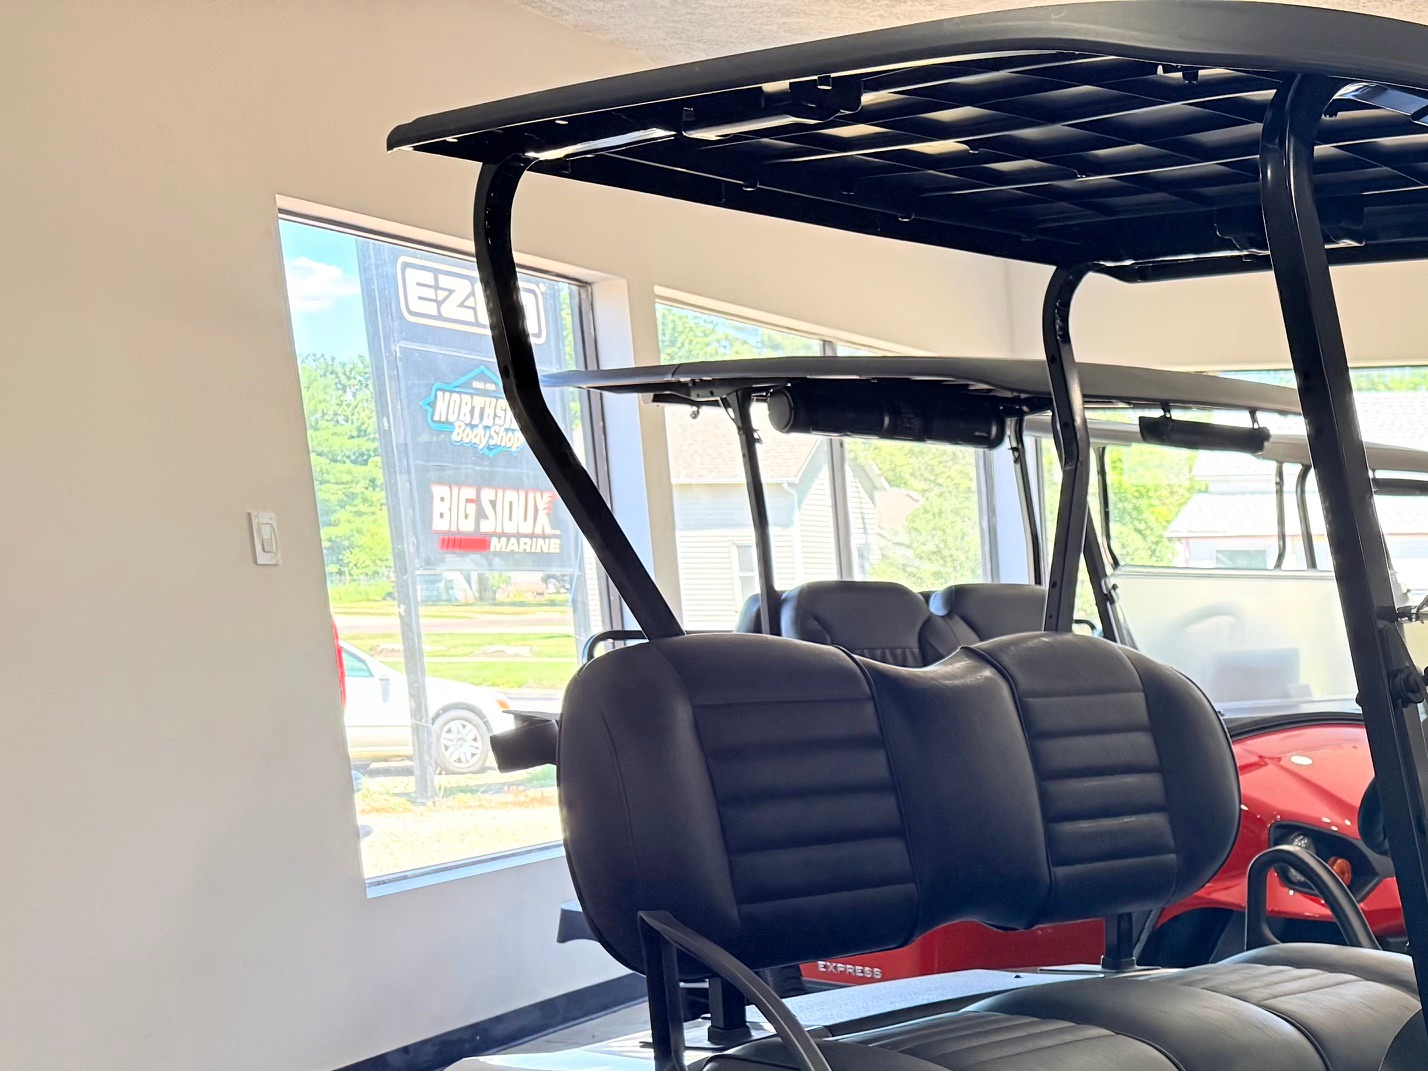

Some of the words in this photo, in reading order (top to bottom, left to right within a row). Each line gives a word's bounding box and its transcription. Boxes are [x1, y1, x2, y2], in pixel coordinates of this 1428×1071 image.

[453, 421, 490, 448] Body
[431, 484, 477, 533] BIG
[479, 487, 560, 535] SIOUX
[490, 536, 561, 553] MARINE
[817, 960, 882, 979] EXPRESS
